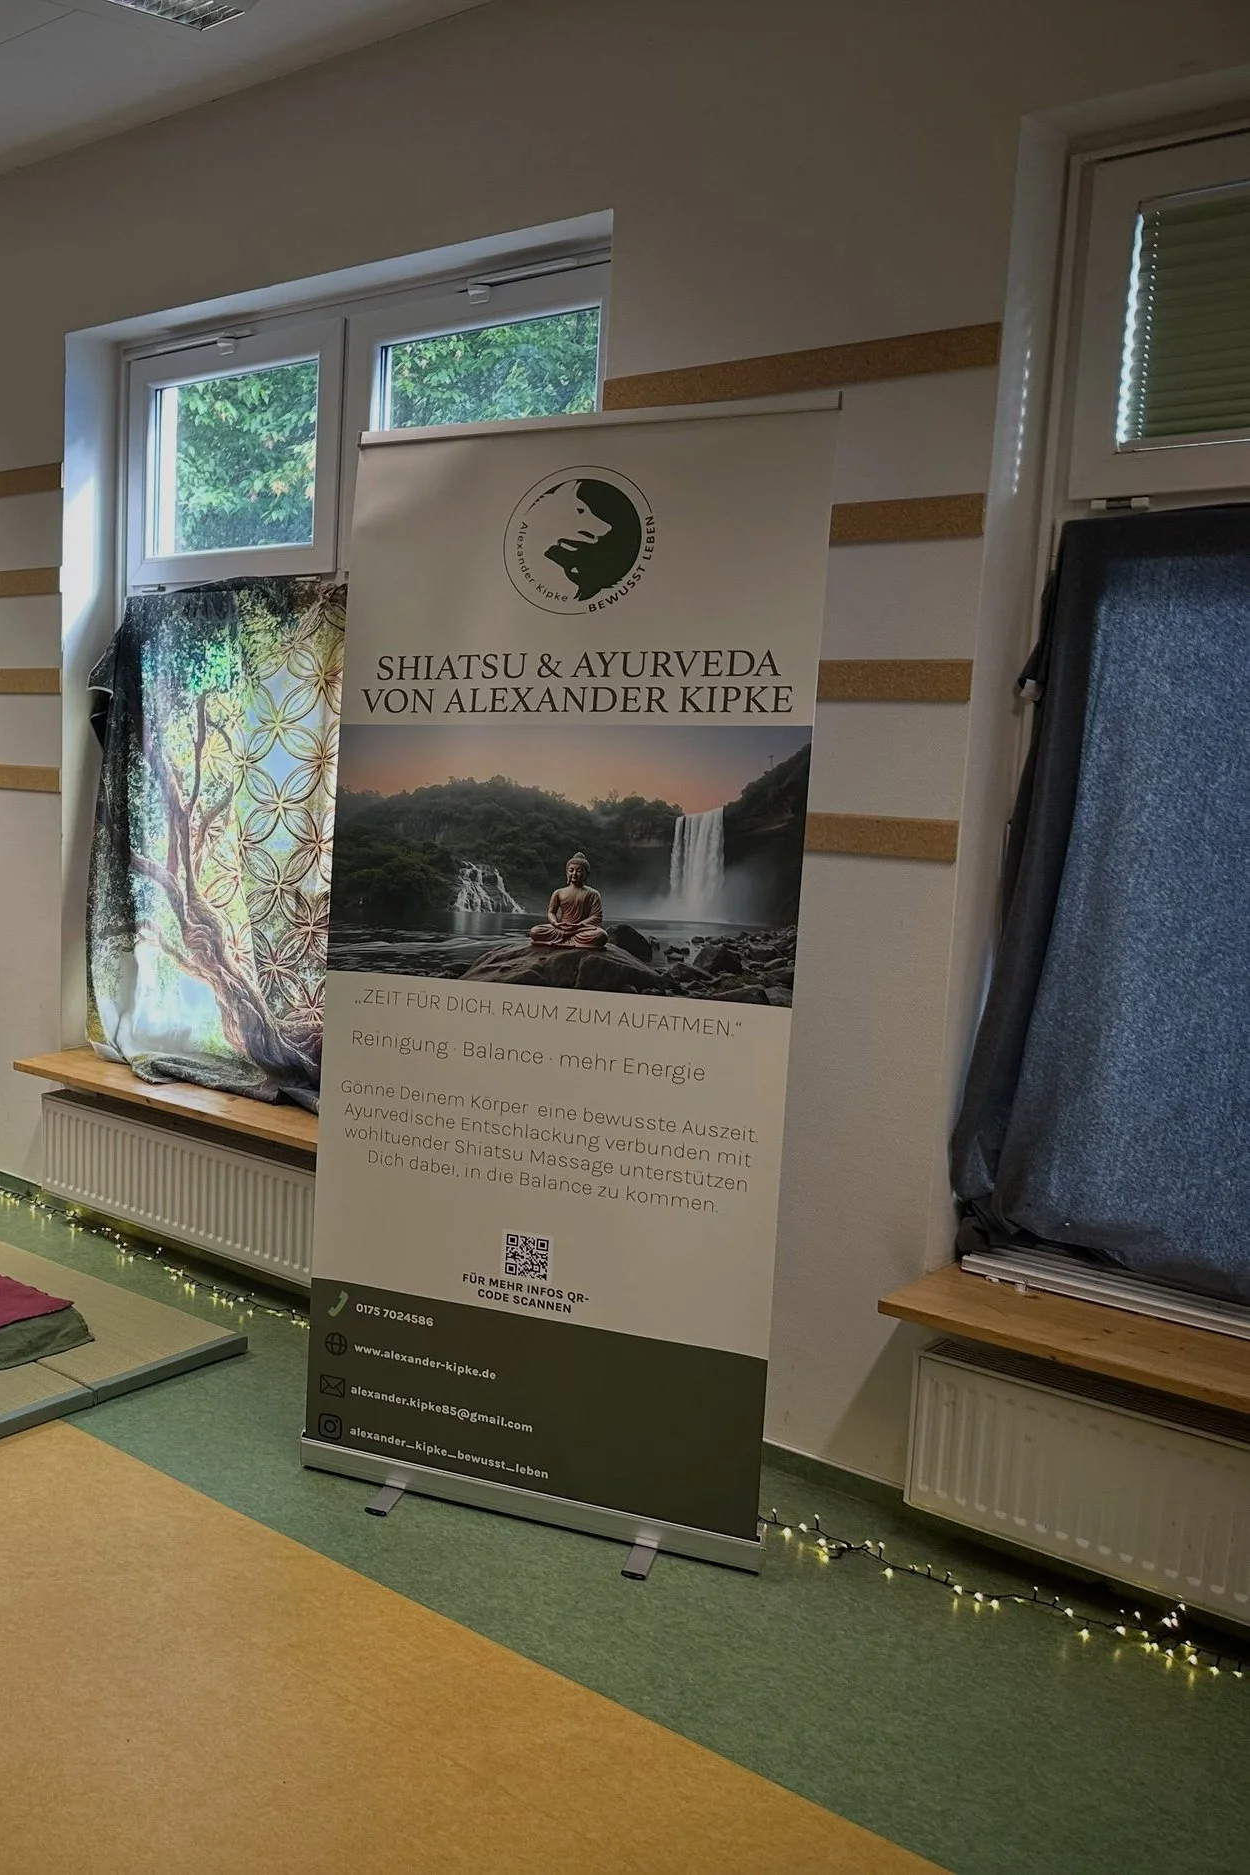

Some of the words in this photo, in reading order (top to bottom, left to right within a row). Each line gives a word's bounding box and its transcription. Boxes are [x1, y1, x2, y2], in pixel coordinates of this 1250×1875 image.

[516, 521, 535, 583] Alexander
[536, 584, 568, 602] Kipke
[588, 564, 646, 613] BEWUSST
[642, 516, 655, 561] LEBEN
[377, 652, 528, 681] SHIATSU
[537, 653, 563, 678] &
[570, 649, 782, 678] AYURVEDA
[361, 688, 436, 714] VON
[442, 686, 669, 713] ALEXANDER
[678, 685, 793, 713] KIPKE
[406, 990, 441, 1010] FÜR
[502, 1000, 558, 1021] RAUM
[565, 1006, 611, 1026] ZUM
[352, 1030, 450, 1060] Reinigung
[463, 1041, 544, 1065] Balance
[559, 1052, 618, 1073] mehr
[623, 1057, 705, 1085] Energie
[341, 1079, 395, 1098] Gönne
[400, 1085, 465, 1107] Deinem
[471, 1093, 529, 1117] Körper
[537, 1103, 577, 1121] eine
[583, 1106, 677, 1133] bewusste
[344, 1102, 456, 1130] Ayurvedische
[461, 1116, 601, 1153] Entschlackung
[604, 1137, 710, 1162] verbunden
[717, 1150, 752, 1168] mit
[344, 1125, 451, 1152] wohltuender
[454, 1139, 523, 1162] Shiatsu
[530, 1149, 614, 1178] Massage
[619, 1164, 748, 1193] unterstützen
[368, 1149, 404, 1168] Dich
[465, 1163, 481, 1180] in
[486, 1166, 514, 1184] die
[519, 1171, 593, 1196] Balance
[597, 1185, 619, 1200] zu
[626, 1185, 718, 1214] kommen.
[462, 1272, 485, 1286] FÜR
[489, 1278, 523, 1293] MEHR
[527, 1284, 564, 1299] INFOS
[567, 1291, 589, 1304] QR-
[477, 1288, 509, 1303] CODE
[512, 1295, 572, 1314] SCANNEN
[356, 1303, 381, 1316] 0175
[383, 1308, 434, 1327] 7024586
[354, 1344, 496, 1380] www.alexander-kipke.de
[350, 1386, 533, 1433] alexander.kipke85@gmail.com
[349, 1427, 549, 1479] alexander_kipke_bewusst_leben
